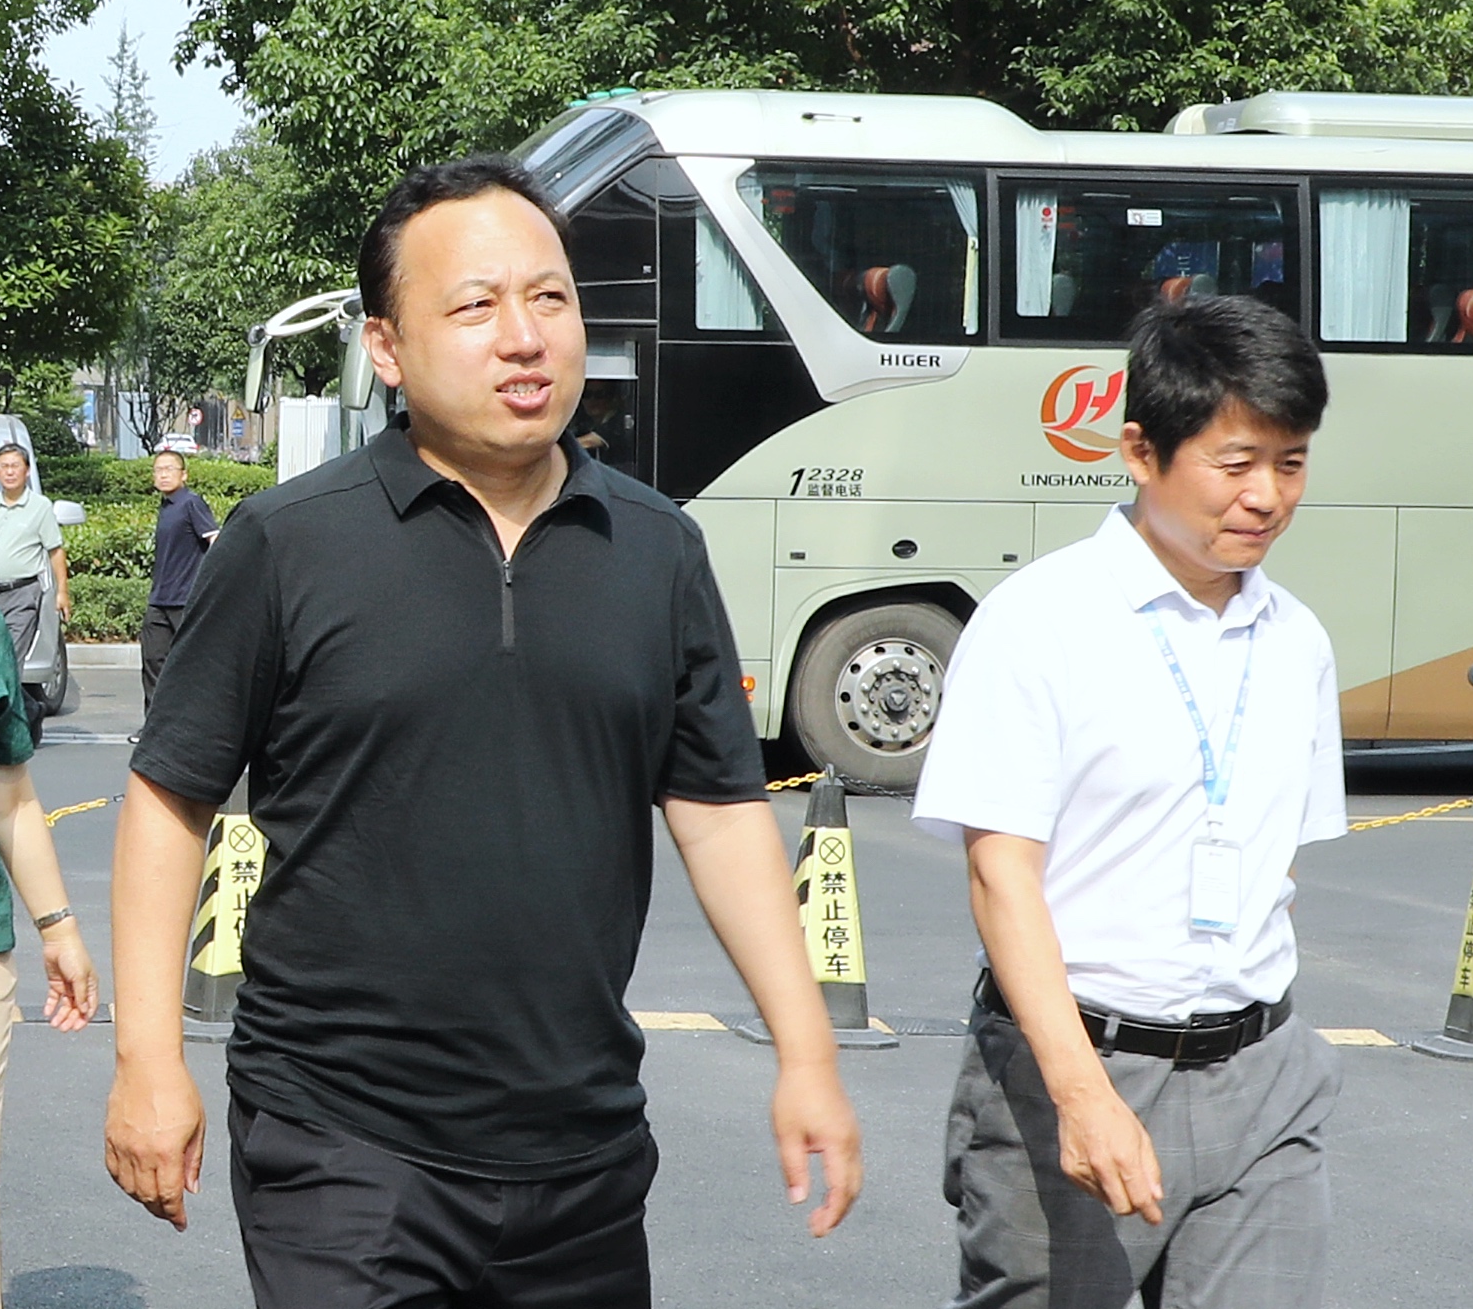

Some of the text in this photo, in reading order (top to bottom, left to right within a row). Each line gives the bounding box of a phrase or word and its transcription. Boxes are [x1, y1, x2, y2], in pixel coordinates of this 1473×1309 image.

[880, 354, 942, 368] HIGER
[789, 467, 865, 497] 12328
[807, 483, 863, 497] 监督电话
[231, 859, 259, 963] 禁止
[820, 870, 851, 977] 禁止停车
